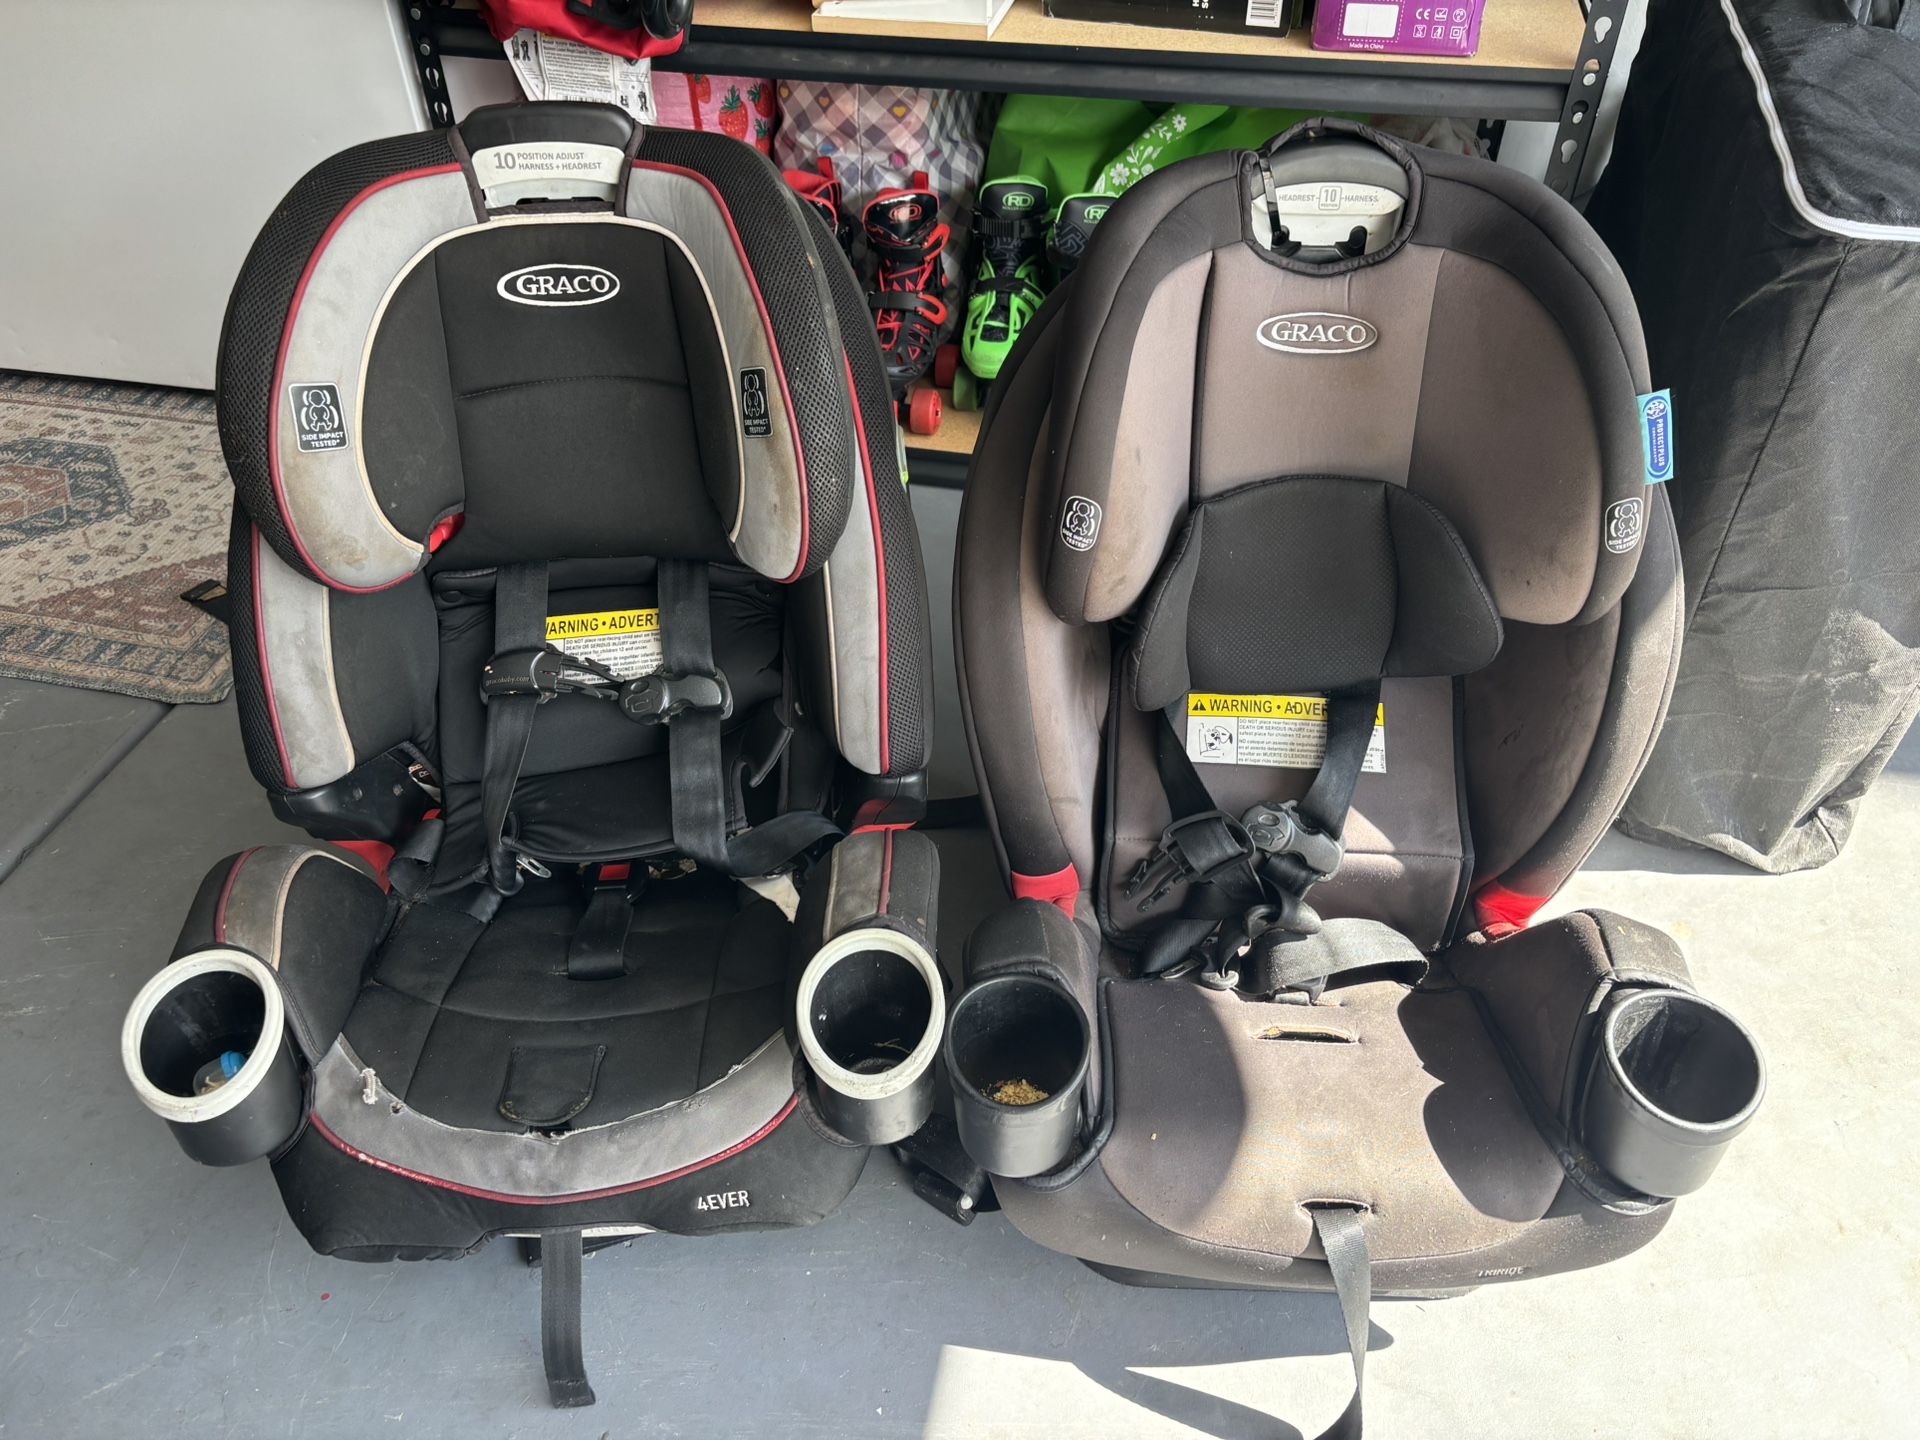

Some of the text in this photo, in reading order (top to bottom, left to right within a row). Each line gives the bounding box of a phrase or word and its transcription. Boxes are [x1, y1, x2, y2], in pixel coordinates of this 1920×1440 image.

[493, 152, 516, 169] 10
[517, 152, 584, 160] POSITION ADJUST
[518, 162, 554, 170] HARNESS
[562, 162, 602, 170] HEADREST
[1324, 189, 1337, 202] 10
[1345, 194, 1378, 202] HARNESS
[516, 274, 610, 295] GRACO
[1271, 321, 1367, 344] GRACO
[301, 431, 344, 441] SIDE IMPACT
[1656, 418, 1665, 467] PROTECTPLUS
[1209, 698, 1272, 713] WARNING
[697, 1190, 751, 1211] 4EVER
